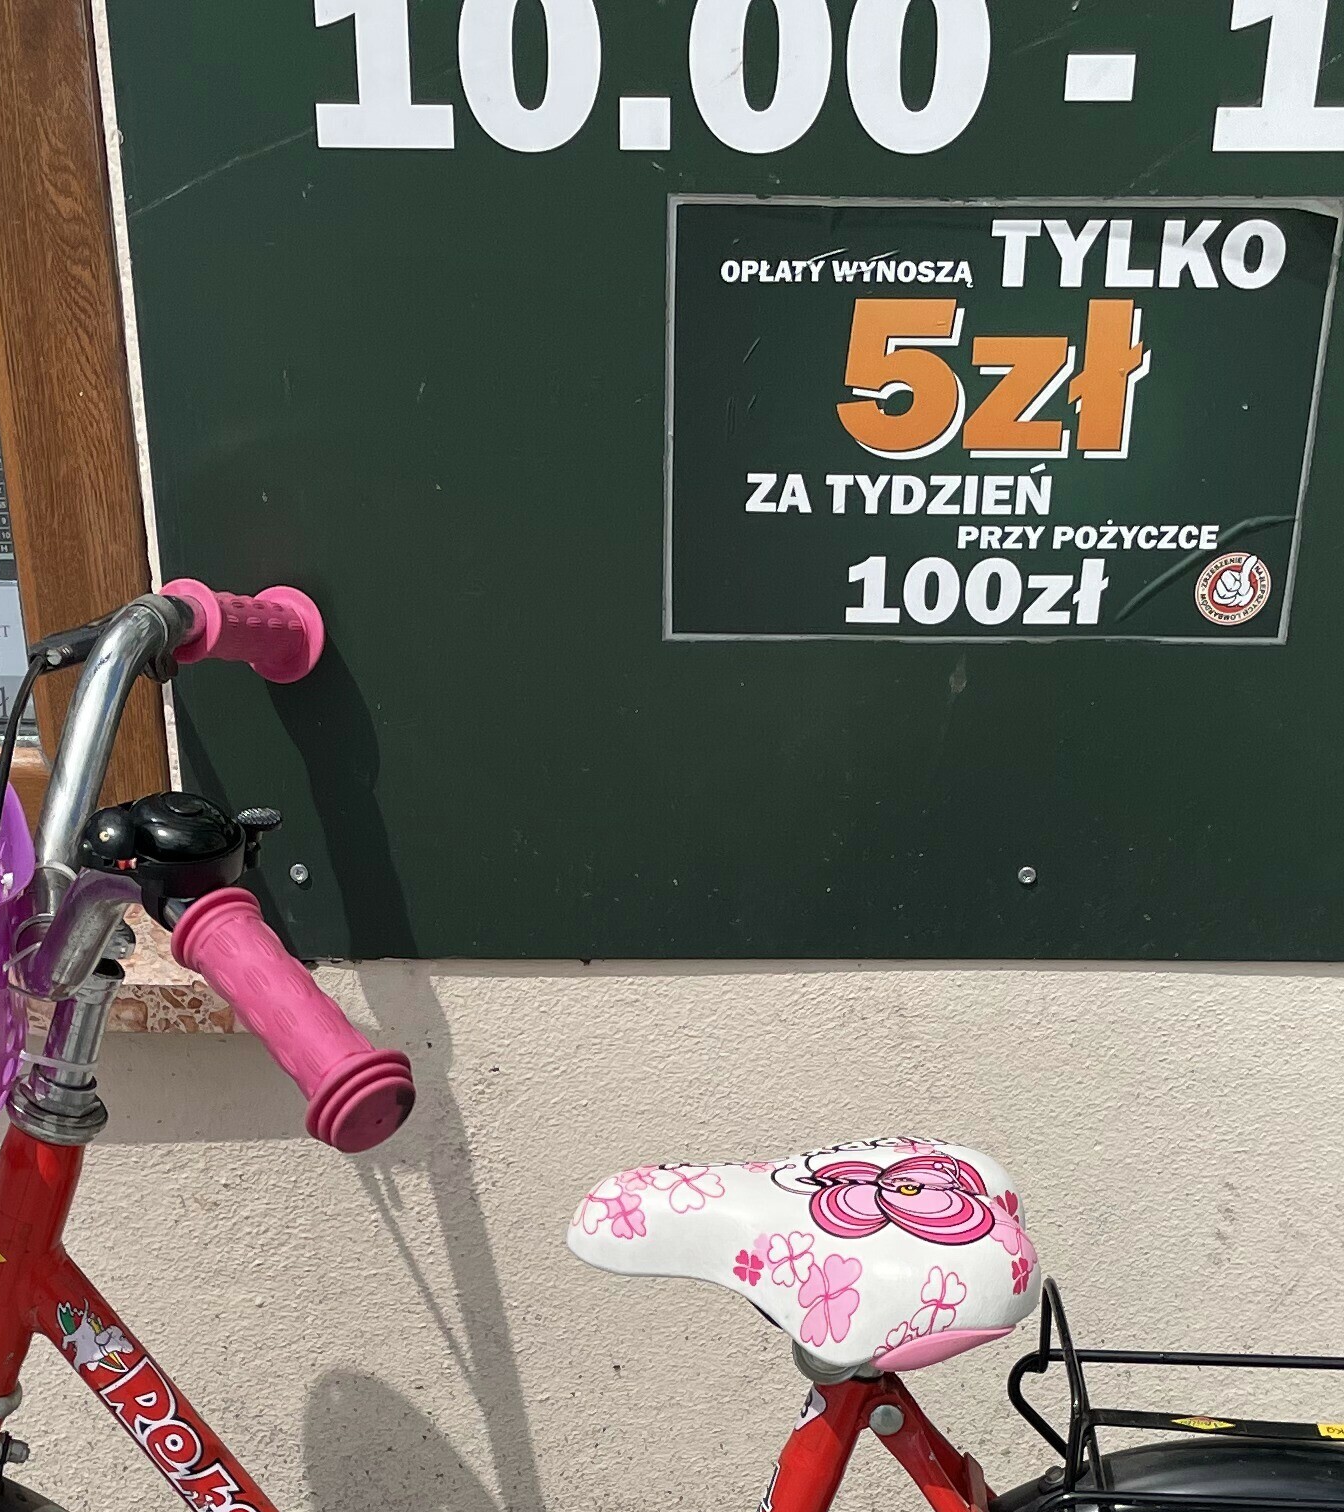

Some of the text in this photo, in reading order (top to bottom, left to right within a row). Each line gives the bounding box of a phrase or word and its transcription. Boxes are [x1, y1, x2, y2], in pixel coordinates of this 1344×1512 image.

[314, 0, 990, 154] 10.00
[1064, 54, 1136, 101] -
[721, 219, 1287, 289] OPŁATY WYNOSZĄ TYLKO
[837, 299, 1151, 459] 5zł
[746, 463, 1052, 515] ZA TYDZIEŃ
[957, 519, 1219, 549] PRZY POŻYCZCE
[846, 557, 1109, 624] 100zł
